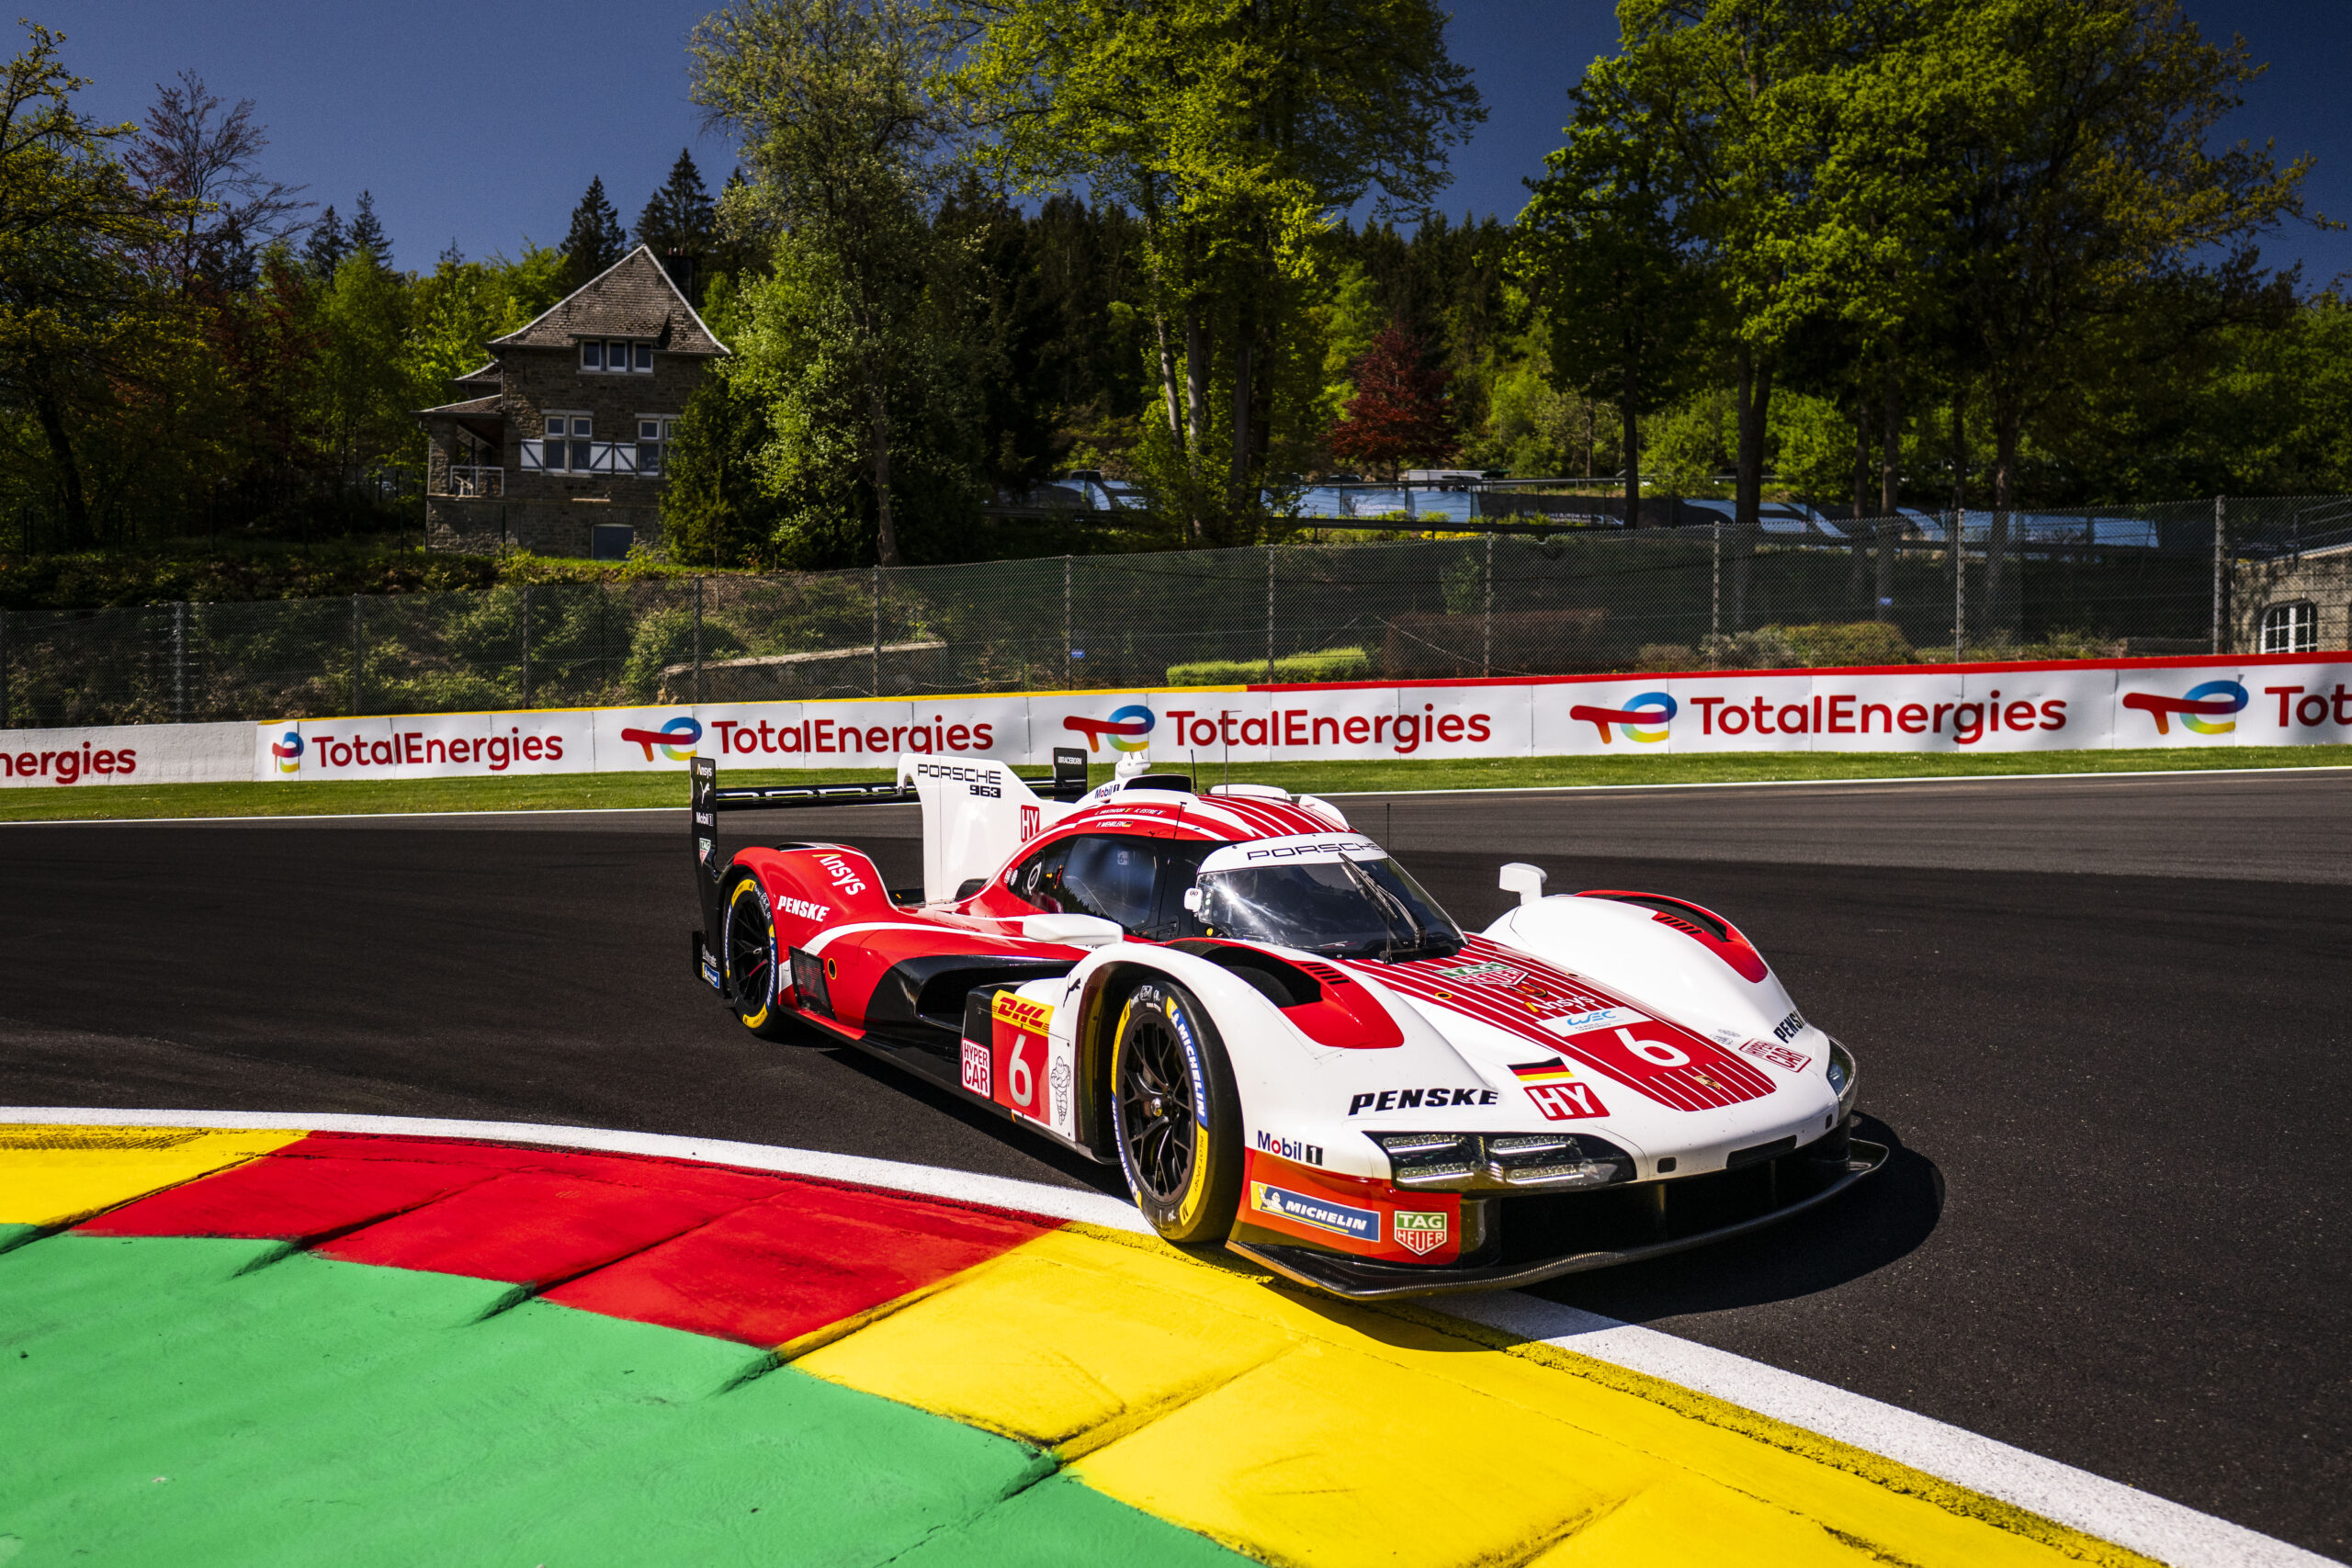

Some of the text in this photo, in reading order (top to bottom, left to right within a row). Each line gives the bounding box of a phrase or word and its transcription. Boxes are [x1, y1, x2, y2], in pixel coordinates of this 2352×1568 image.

[1689, 690, 2066, 746] TotalEnergies
[2264, 683, 2352, 728] Tot
[710, 714, 993, 755] TotalEnergies
[1165, 703, 1491, 755] TotalEnergies
[0, 741, 137, 784] nergies
[311, 727, 563, 772] TotalEnergies
[696, 762, 712, 779] Ansys
[918, 763, 1001, 785] PORSCHE
[969, 784, 1001, 799] 963
[1094, 785, 1113, 799] Mobil
[695, 812, 708, 825] Mobil
[1022, 809, 1038, 840] HY
[1247, 842, 1382, 861] PORSCHE
[811, 853, 866, 896] Ansys
[776, 895, 831, 922] PENSKE
[1439, 964, 1505, 976] TAG
[997, 997, 1046, 1029] DHL
[1525, 996, 1595, 1013] Ansys
[1566, 1010, 1617, 1026] WEC
[964, 1043, 989, 1068] HYPER
[1614, 1028, 1690, 1067] 6
[1765, 1047, 1805, 1068] CAR
[964, 1060, 989, 1093] CAR
[1009, 1033, 1033, 1107] 6
[1177, 1023, 1205, 1118] MICHELIN
[1348, 1088, 1498, 1116] PENSKE
[1527, 1085, 1596, 1117] HY
[1258, 1130, 1319, 1166] Mobil 1
[1285, 1200, 1368, 1232] MICHELIN
[1398, 1213, 1442, 1229] TAG
[1397, 1230, 1445, 1252] HEUER
